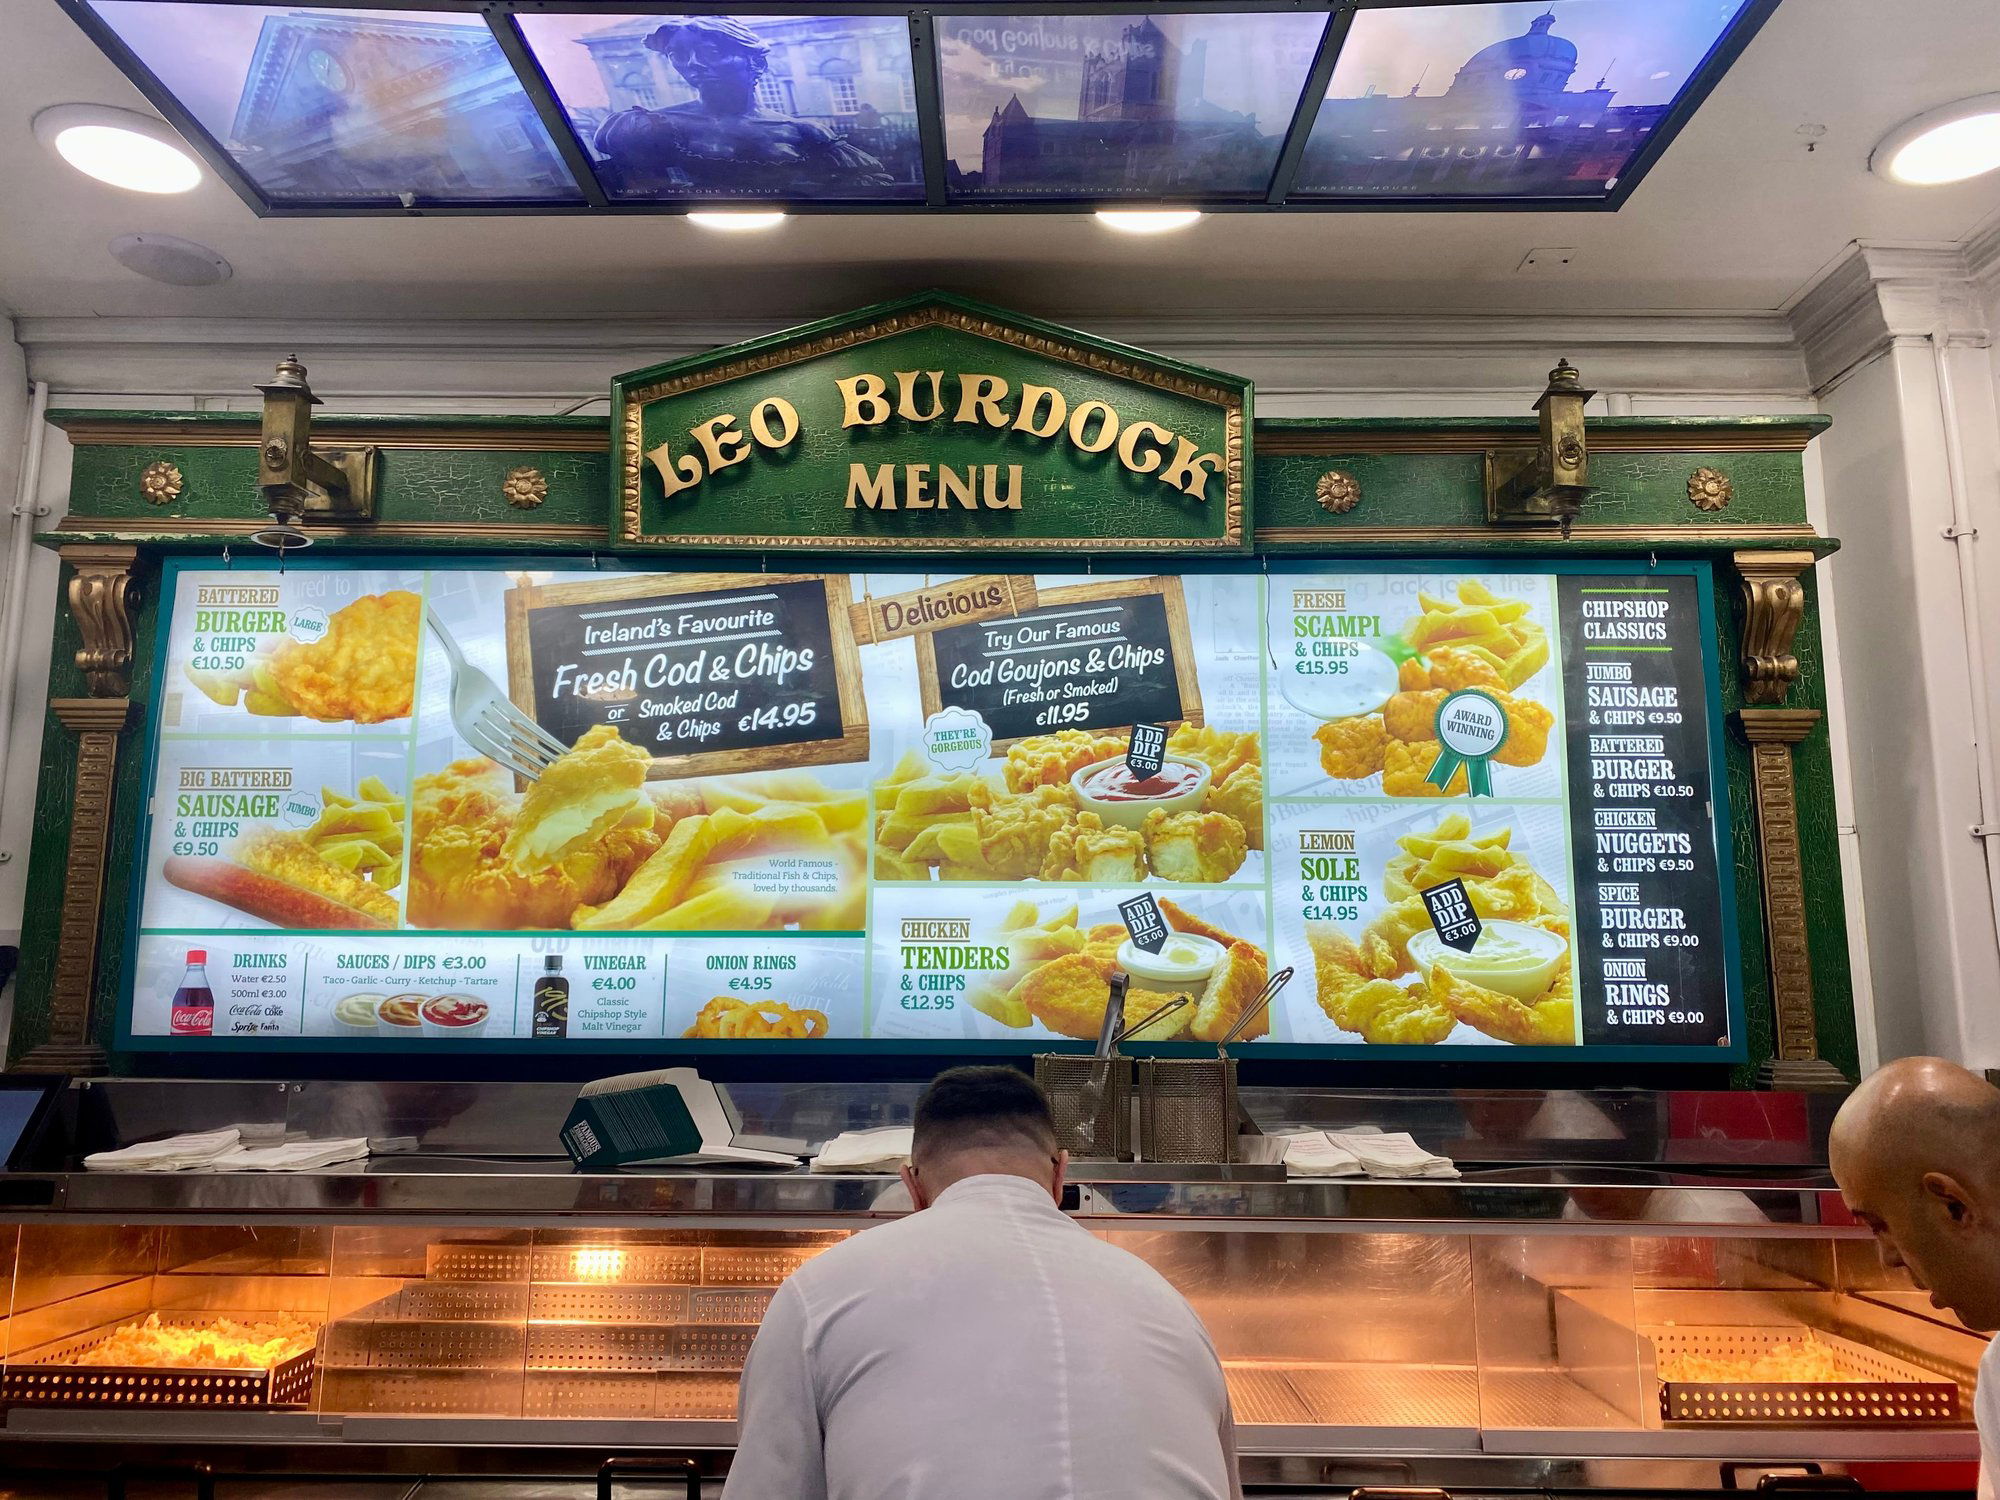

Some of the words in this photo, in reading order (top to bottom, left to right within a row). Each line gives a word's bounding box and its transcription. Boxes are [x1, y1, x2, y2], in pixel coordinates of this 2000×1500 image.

[644, 395, 802, 499] LEO
[834, 369, 1227, 503] BURDOCK
[844, 462, 1023, 511] MENU
[198, 588, 279, 605] BATTERED
[1293, 593, 1346, 609] FRESH
[880, 585, 1003, 632] Delicious
[1582, 600, 1669, 618] CHIPSHOP
[195, 611, 287, 633] BURGER
[293, 617, 323, 632] LARGE
[584, 619, 672, 646] Ireland's
[678, 610, 774, 637] Favourite
[1293, 615, 1381, 638] SCAMPI
[985, 630, 1013, 651] Try
[1016, 626, 1050, 645] Our
[1055, 619, 1121, 640] Famous
[1584, 622, 1667, 640] CLASSICS
[193, 637, 205, 652] &
[210, 637, 256, 653] CHIPS
[1295, 642, 1308, 657] &
[1313, 642, 1359, 657] CHIPS
[192, 656, 245, 670] €10.50
[552, 657, 637, 699] Fresh
[645, 649, 706, 689] Cod
[709, 658, 731, 681] &
[734, 643, 814, 685] Chips
[950, 662, 995, 689] Cod
[997, 655, 1081, 688] Goujons
[1085, 649, 1106, 672] &
[1107, 644, 1165, 676] Chips
[1295, 661, 1348, 675] €15.95
[1586, 666, 1632, 680] JUMBO
[1002, 687, 1046, 706] (Fresh
[1046, 688, 1061, 701] or
[1062, 676, 1119, 700] Smoked)
[1588, 687, 1678, 707] SAUSAGE
[607, 707, 625, 720] or
[638, 694, 701, 720] Smoked
[704, 690, 739, 712] Cod
[656, 726, 673, 741] &
[677, 718, 721, 742] Chips
[738, 702, 816, 733] €14.95
[1035, 702, 1090, 727] €11.95
[1453, 708, 1492, 727] AWARD
[1589, 710, 1601, 725] &
[1604, 710, 1646, 725] CHIPS
[1648, 713, 1682, 724] €9.50
[934, 728, 977, 743] THEY'RE
[1134, 728, 1163, 746] ADD
[1446, 720, 1495, 741] WINNING
[930, 738, 982, 754] GORGEOUS
[1131, 740, 1162, 758] DIP
[1590, 738, 1665, 753] BATTERED
[1130, 758, 1158, 772] €3.00
[1592, 760, 1676, 780] BURGER
[180, 771, 205, 787] BIG
[211, 771, 292, 788] BATTERED
[1593, 784, 1605, 798] &
[1609, 783, 1651, 798] CHIPS
[1653, 786, 1694, 797] €10.50
[177, 794, 279, 818] SAUSAGE
[286, 802, 316, 818] JUMBO
[1594, 812, 1656, 826] CHICKEN
[174, 822, 187, 838] &
[192, 822, 239, 838] CHIPS
[173, 842, 218, 856] €9.50
[1299, 834, 1355, 850] LEMON
[1596, 833, 1692, 854] NUGGETS
[768, 859, 796, 868] World
[798, 859, 833, 868] Famous
[1301, 857, 1360, 881] SOLE
[1597, 858, 1610, 872] &
[1613, 858, 1656, 873] CHIPS
[1659, 859, 1694, 871] €9.50
[732, 871, 781, 880] Traditional
[782, 871, 801, 880] Fish
[802, 871, 810, 880] &
[811, 871, 839, 882] Chips,
[753, 883, 777, 893] loved
[778, 883, 790, 895] by
[791, 883, 838, 893] thousands.
[1301, 885, 1315, 902] &
[1320, 885, 1368, 902] CHIPS
[1599, 887, 1640, 901] SPICE
[1430, 887, 1463, 911] ADD
[1126, 900, 1153, 921] ADD
[1302, 906, 1358, 920] €14.95
[1436, 902, 1469, 928] DIP
[1600, 908, 1686, 930] BURGER
[901, 922, 970, 939] CHICKEN
[1129, 912, 1157, 934] DIP
[1137, 929, 1164, 946] €3.00
[1444, 923, 1477, 941] €3.00
[1602, 933, 1614, 948] &
[1617, 933, 1660, 948] CHIPS
[1663, 935, 1699, 947] €9.00
[233, 953, 287, 968] DRINKS
[337, 954, 390, 970] SAUCES
[392, 954, 400, 971] /
[403, 954, 436, 970] DIPS
[442, 956, 487, 970] €3.00
[584, 955, 647, 970] VINEGAR
[706, 955, 750, 970] ONION
[753, 955, 797, 970] RINGS
[901, 946, 1010, 970] TENDERS
[1603, 962, 1646, 978] ONION
[231, 974, 260, 984] Water
[261, 974, 287, 984] €2.50
[322, 976, 345, 985] Taco
[351, 976, 378, 985] Garlic
[385, 976, 411, 987] Curry
[419, 976, 457, 987] Ketchup
[464, 977, 498, 986] Tartare
[592, 976, 636, 990] €4.00
[728, 976, 772, 991] €4.95
[901, 975, 913, 991] &
[919, 974, 966, 991] CHIPS
[231, 989, 260, 998] 500ml
[261, 989, 287, 999] €3.00
[597, 997, 629, 1007] Classic
[901, 995, 955, 1010] €12.95
[1605, 984, 1670, 1006] RINGS
[578, 1009, 623, 1021] Chipshop
[624, 1009, 648, 1021] Style
[1606, 1010, 1619, 1025] &
[1622, 1010, 1666, 1025] CHIPS
[1668, 1012, 1704, 1024] €9.00
[582, 1022, 603, 1031] Malt
[605, 1022, 642, 1033] Vinegar
[577, 1119, 602, 1152] FAMOUS
